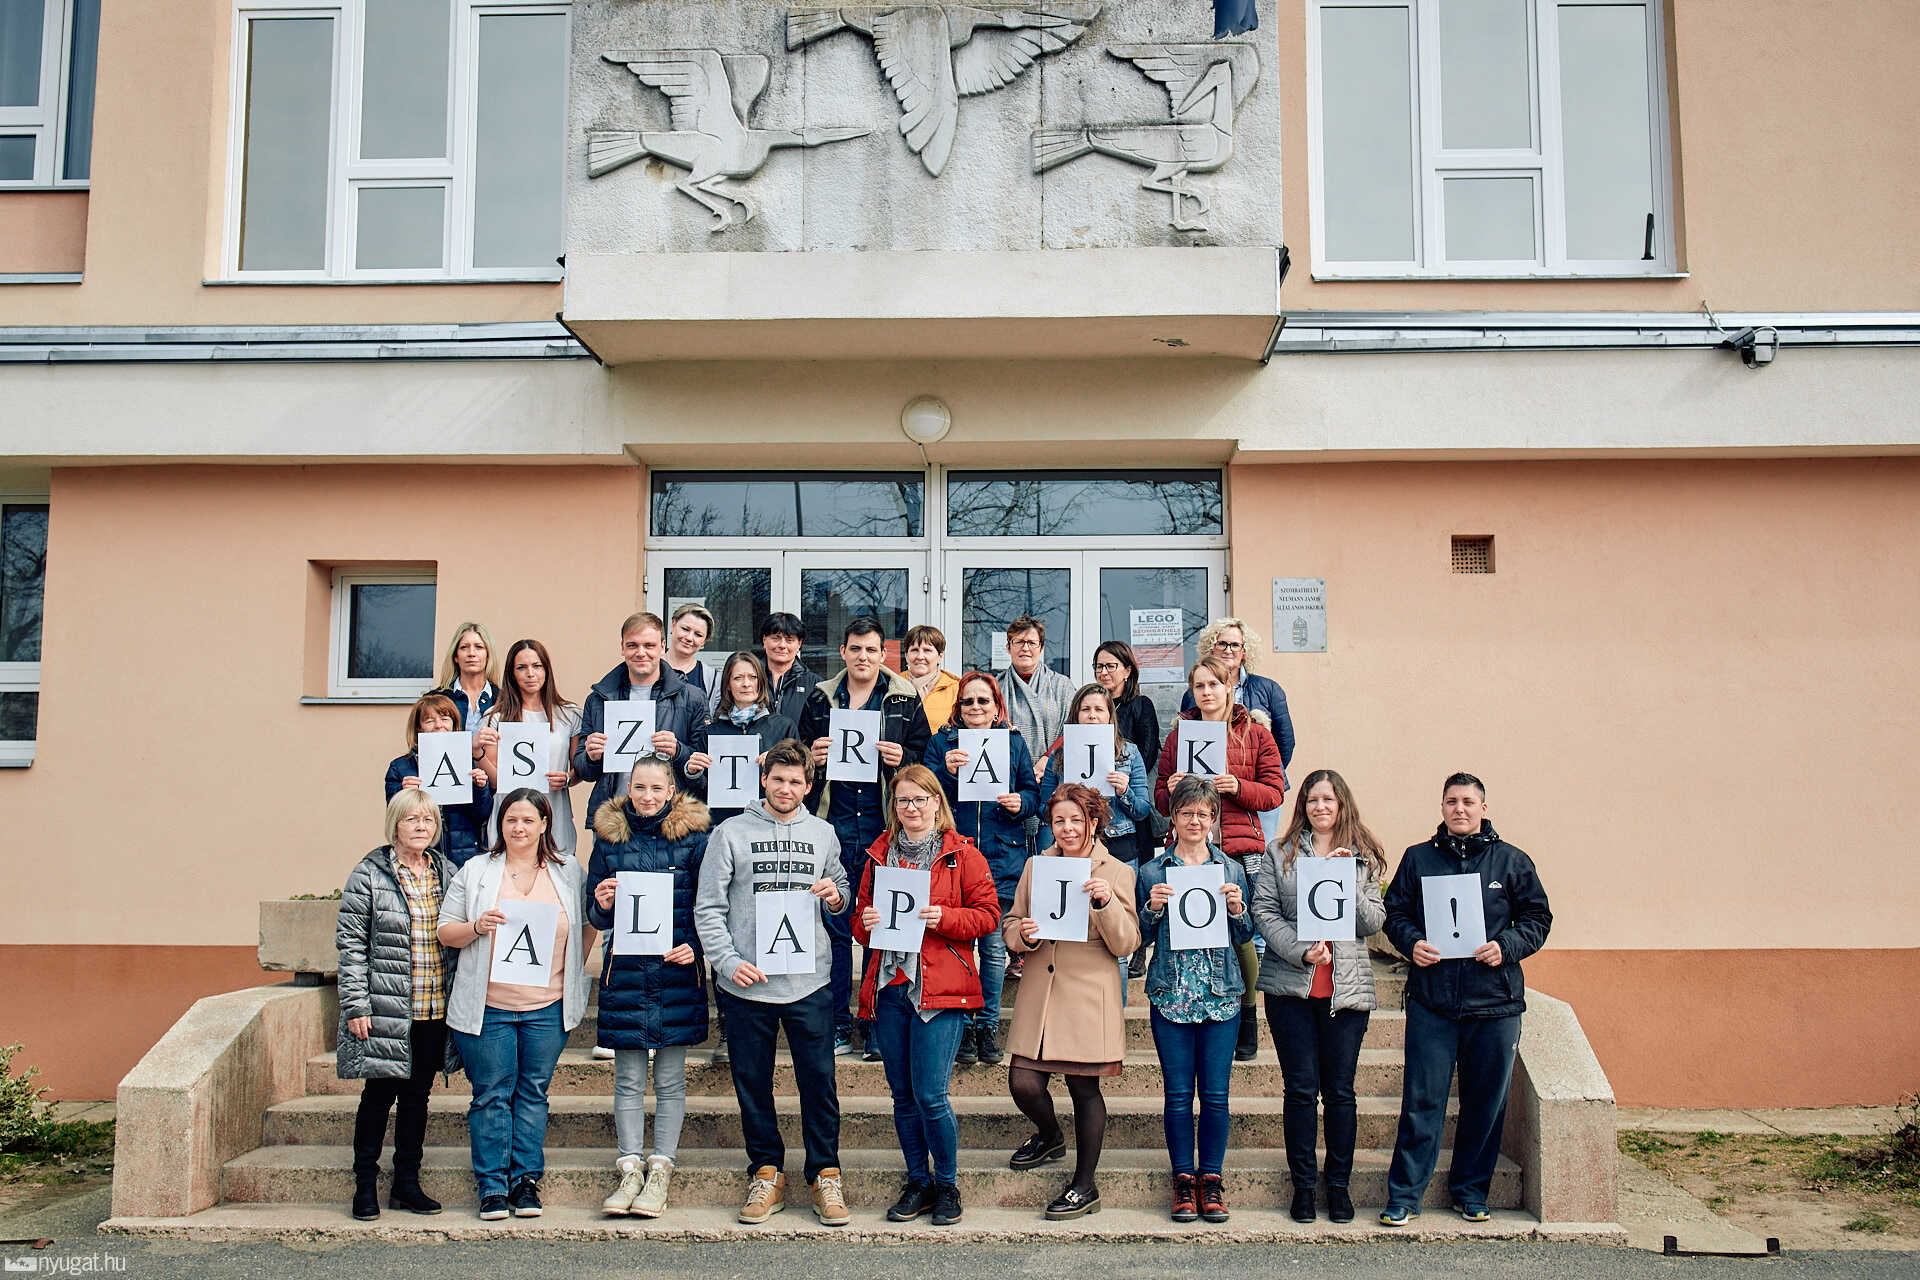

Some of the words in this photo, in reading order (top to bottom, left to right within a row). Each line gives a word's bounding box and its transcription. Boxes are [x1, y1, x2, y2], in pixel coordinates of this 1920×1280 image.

[1138, 614, 1175, 623] LEGO
[614, 720, 645, 756] Z
[839, 728, 871, 765] R
[1184, 739, 1219, 775] K
[427, 751, 463, 787] A
[512, 741, 536, 776] S
[719, 755, 749, 790] T
[965, 737, 1003, 784] Á
[1080, 744, 1097, 780] J
[756, 842, 775, 852] THE
[628, 894, 661, 935] L
[885, 889, 916, 931] P
[1049, 879, 1073, 921] J
[1178, 887, 1217, 929] O
[1307, 879, 1348, 922] G
[1449, 896, 1460, 939] !
[502, 923, 542, 966] A
[765, 912, 806, 955] A
